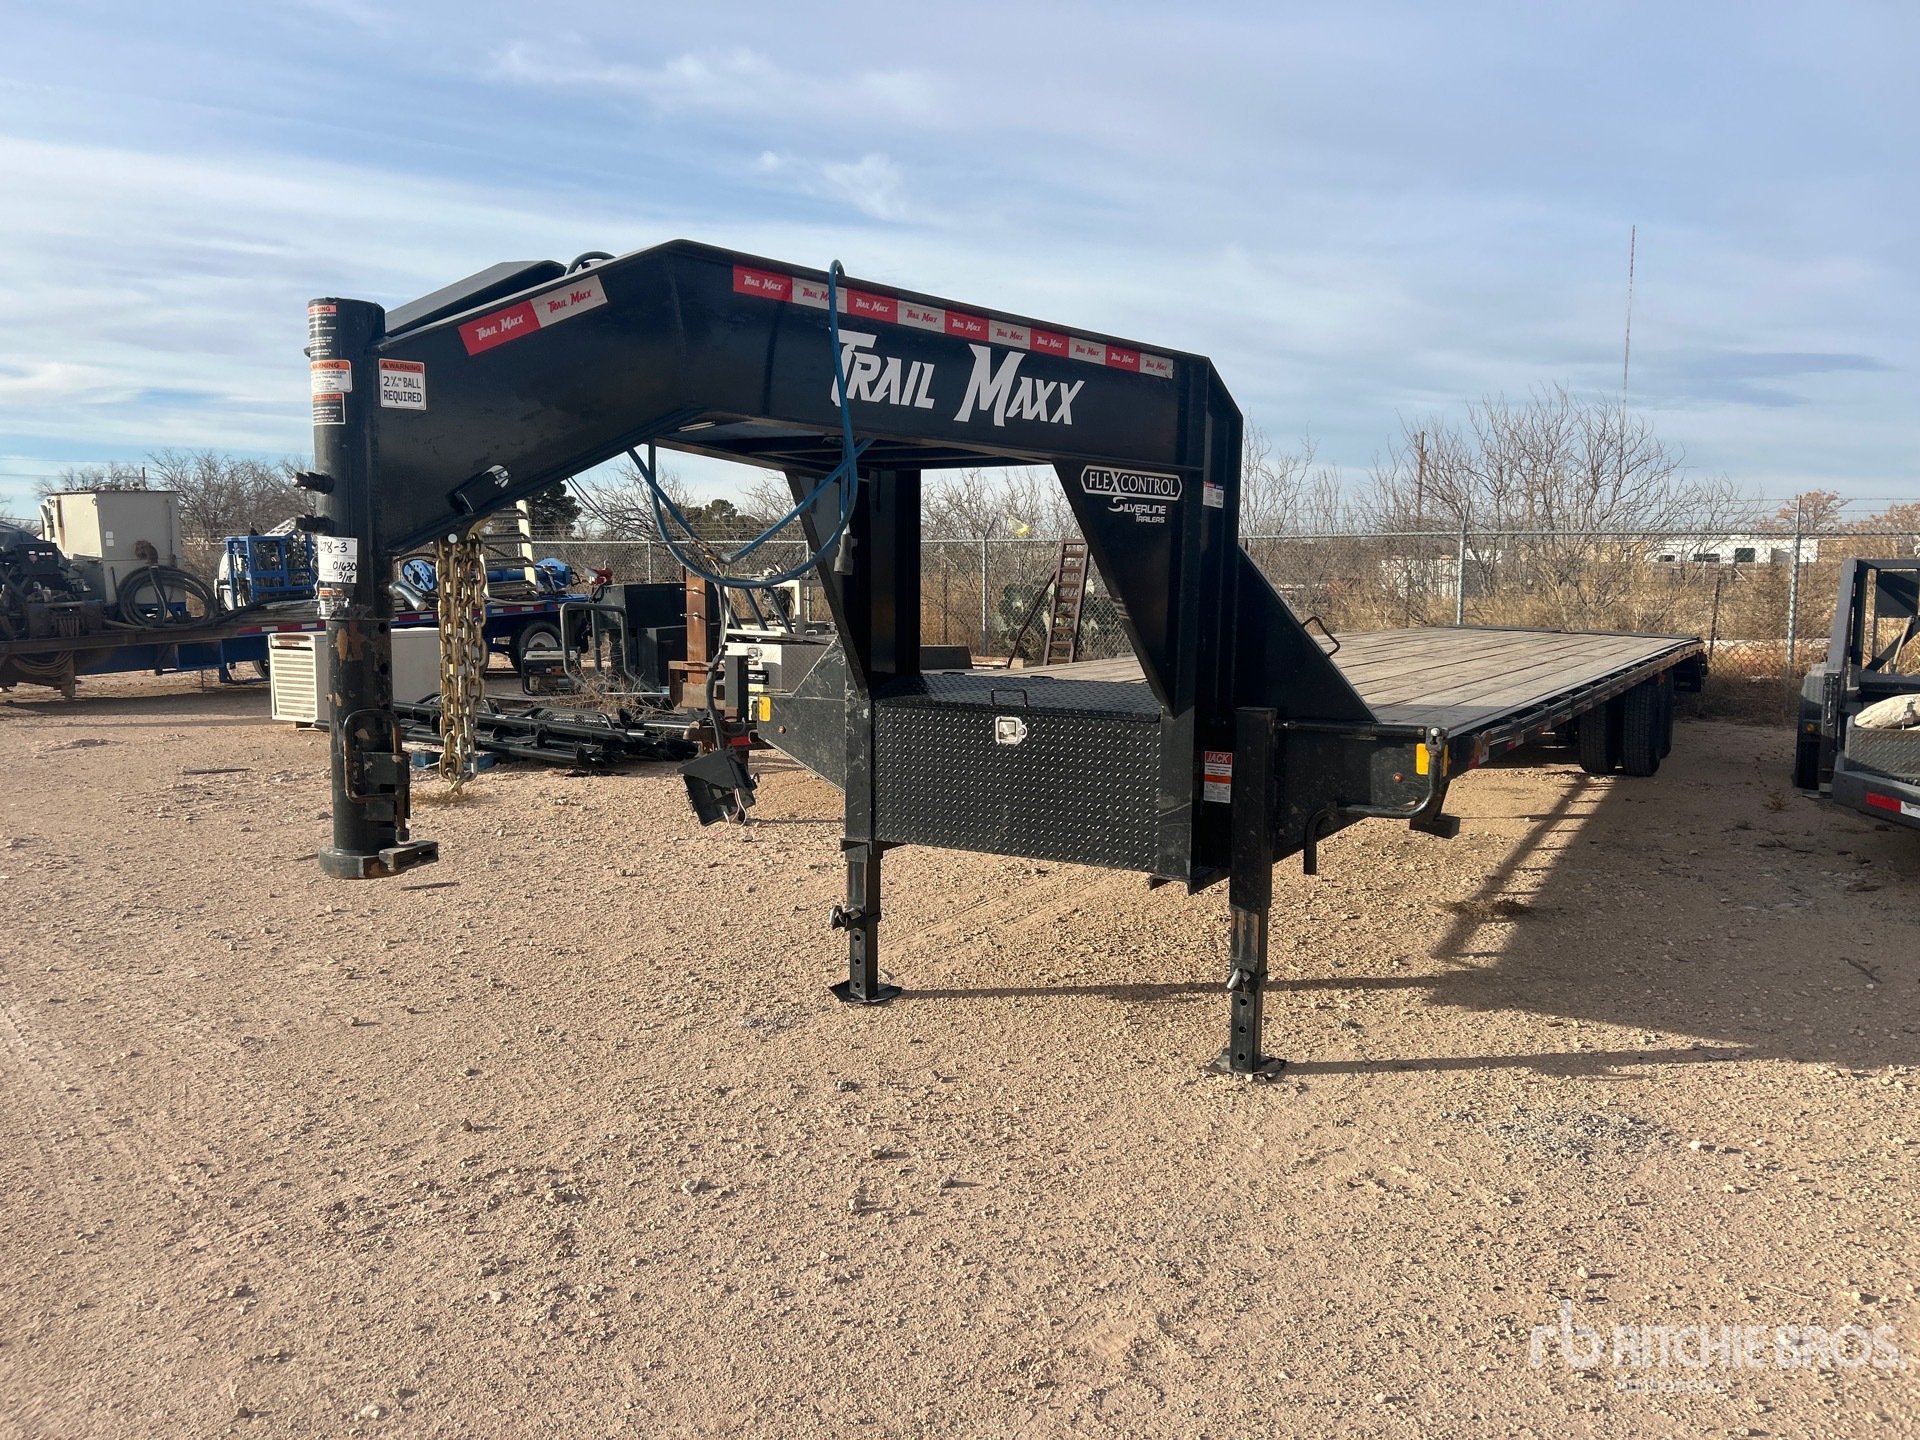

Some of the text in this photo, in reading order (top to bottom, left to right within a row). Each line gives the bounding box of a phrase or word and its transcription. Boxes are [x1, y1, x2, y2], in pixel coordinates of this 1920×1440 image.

[548, 289, 592, 313] TRAIL MAXX
[475, 314, 524, 341] TRAIL MAXX
[389, 362, 421, 372] WARNING
[403, 377, 421, 389] BALL
[828, 327, 1085, 427] TRAIL MAXX
[383, 390, 422, 404] REQUIRED
[1089, 470, 1176, 496] FLEXCONTROL
[1106, 497, 1167, 515] SILVERLINE
[1135, 513, 1166, 524] TRAILERS
[1206, 753, 1230, 764] JACK
